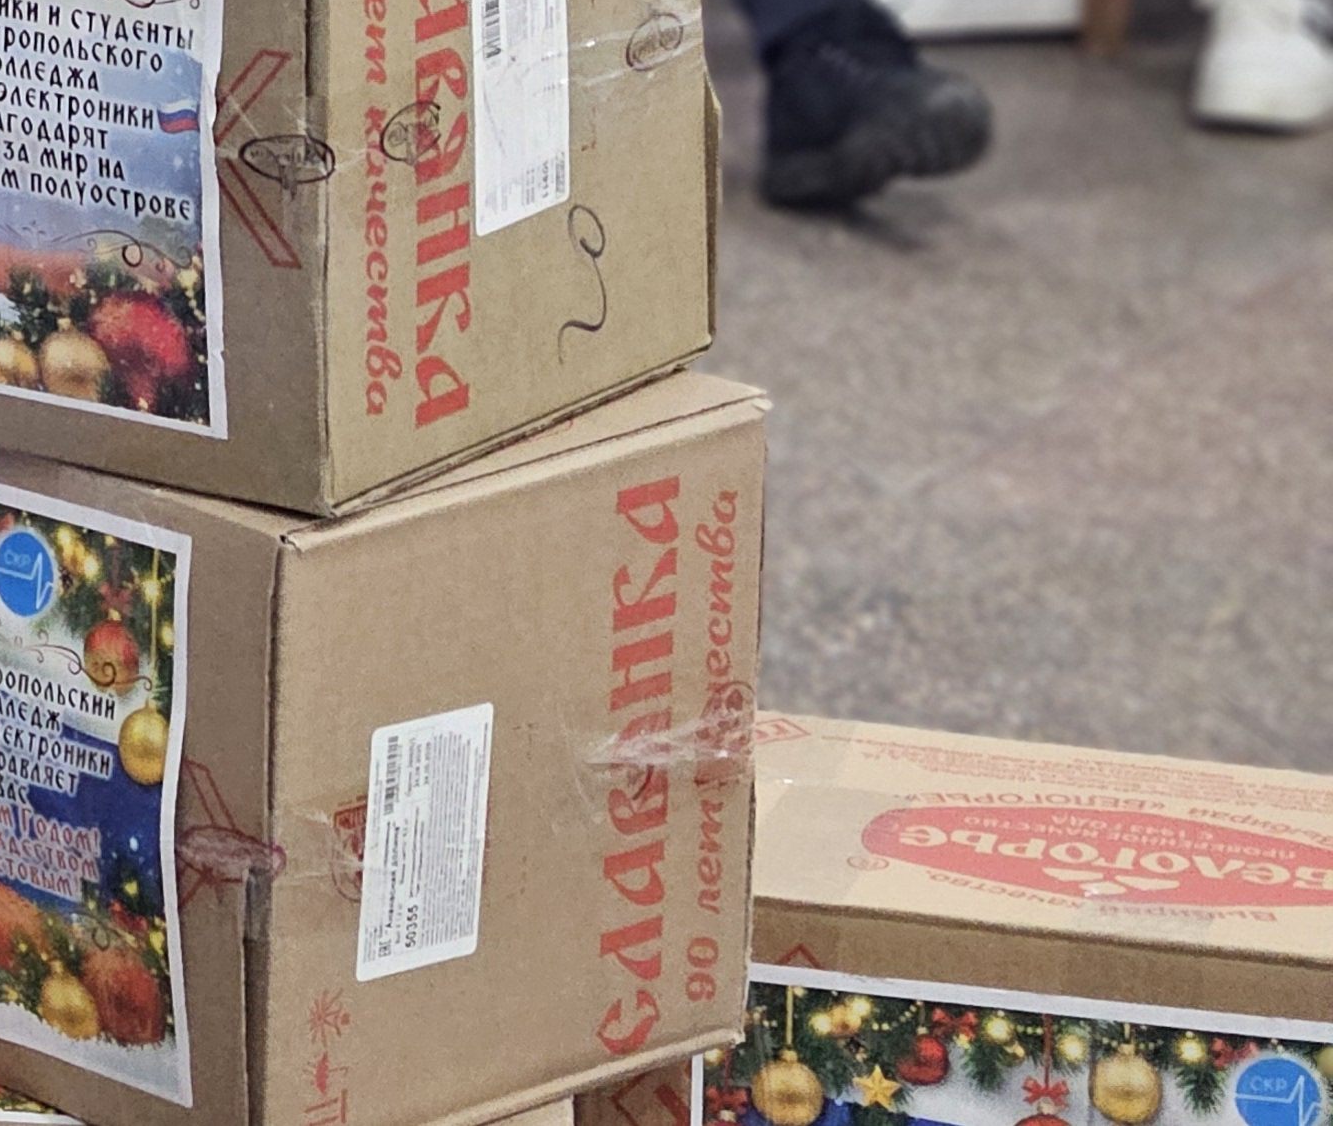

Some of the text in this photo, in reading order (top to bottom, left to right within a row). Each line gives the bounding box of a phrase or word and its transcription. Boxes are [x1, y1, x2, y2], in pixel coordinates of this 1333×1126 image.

[48, 5, 62, 27] и
[70, 7, 195, 51] студенты
[3, 139, 30, 164] за
[40, 146, 88, 174] мир
[98, 156, 126, 181] на
[30, 171, 192, 221] полуострове
[365, 104, 403, 416] качества
[21, 804, 101, 854] Годом!
[964, 816, 1099, 839] КАЧЕСТВО
[1052, 813, 1123, 833] ГОДА
[697, 800, 724, 915] лет
[405, 905, 419, 948] 50355
[685, 936, 719, 1002] 90
[1250, 1077, 1288, 1093] СКР
